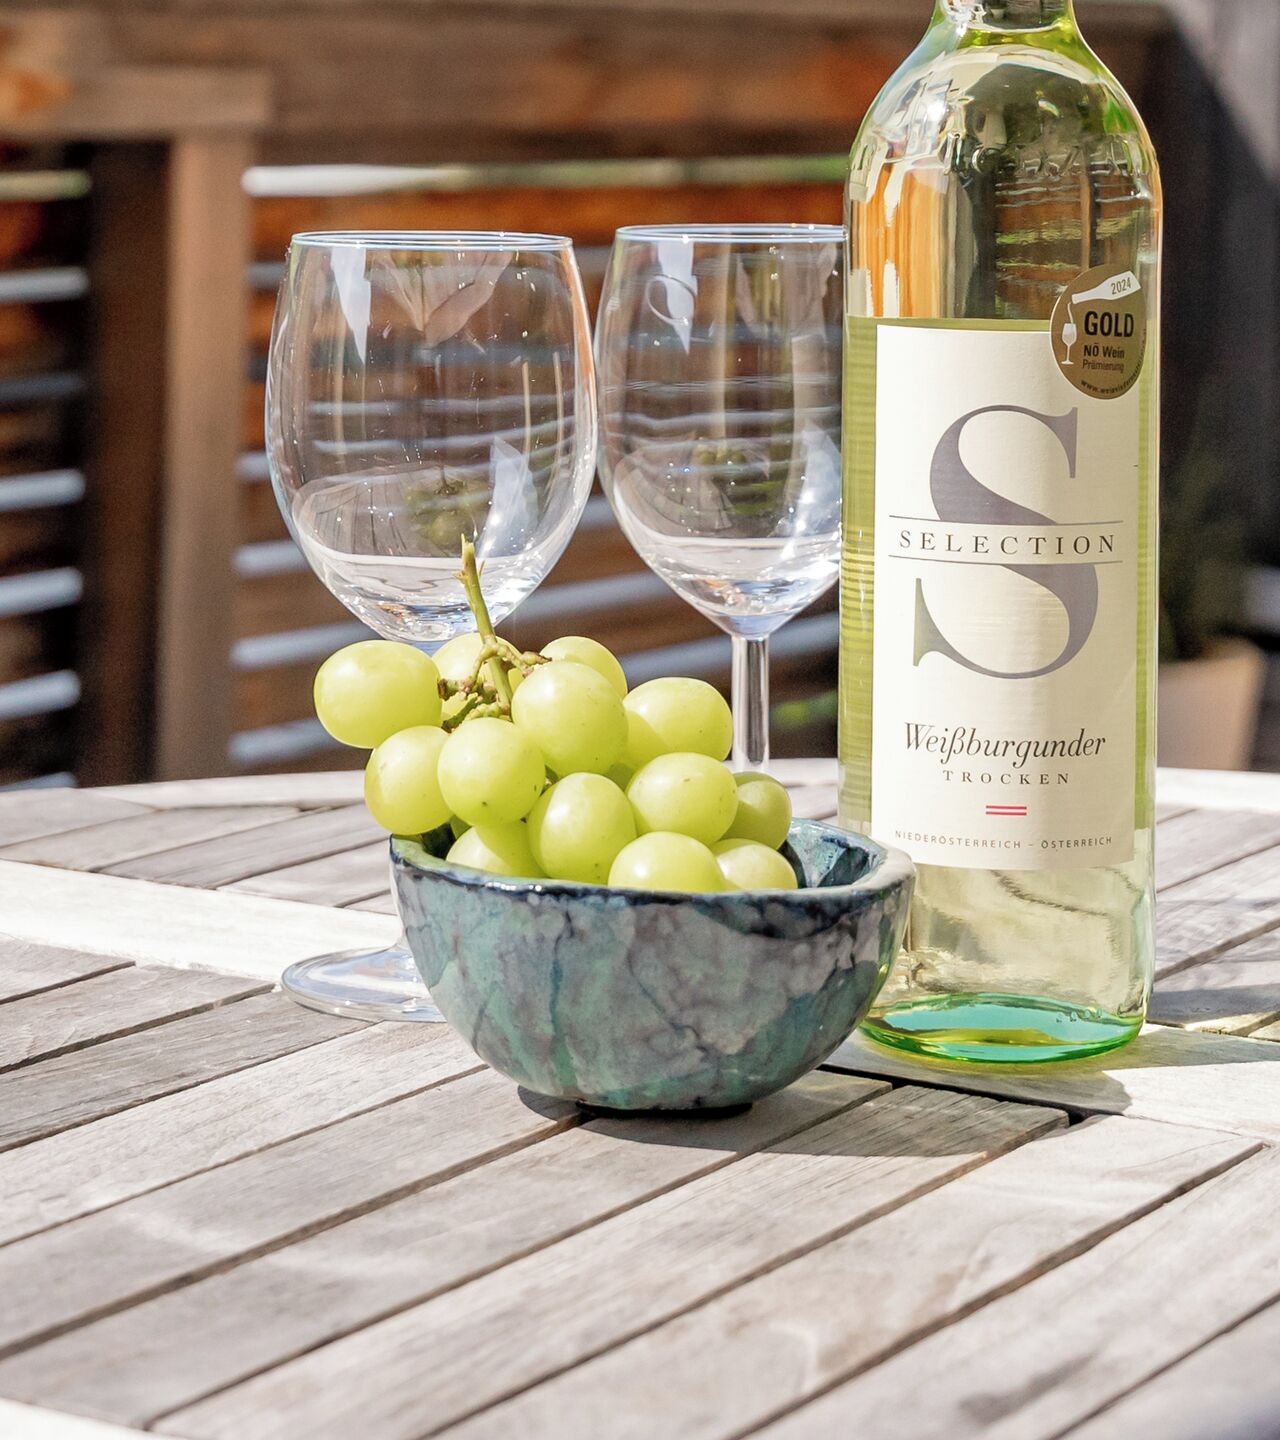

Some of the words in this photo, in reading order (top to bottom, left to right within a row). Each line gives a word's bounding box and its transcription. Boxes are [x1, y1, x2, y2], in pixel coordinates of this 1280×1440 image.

[1111, 277, 1131, 295] 2024
[1084, 311, 1135, 338] GOLD
[1102, 346, 1125, 359] Wein
[899, 530, 1115, 555] SELECTION
[913, 405, 1098, 679] S
[904, 721, 1106, 769] Weißburgunder
[943, 770, 1070, 785] TROCKEN
[895, 830, 1021, 849] NIEDERÖSTERREICH
[1041, 836, 1113, 849] ÖSTERREICH
